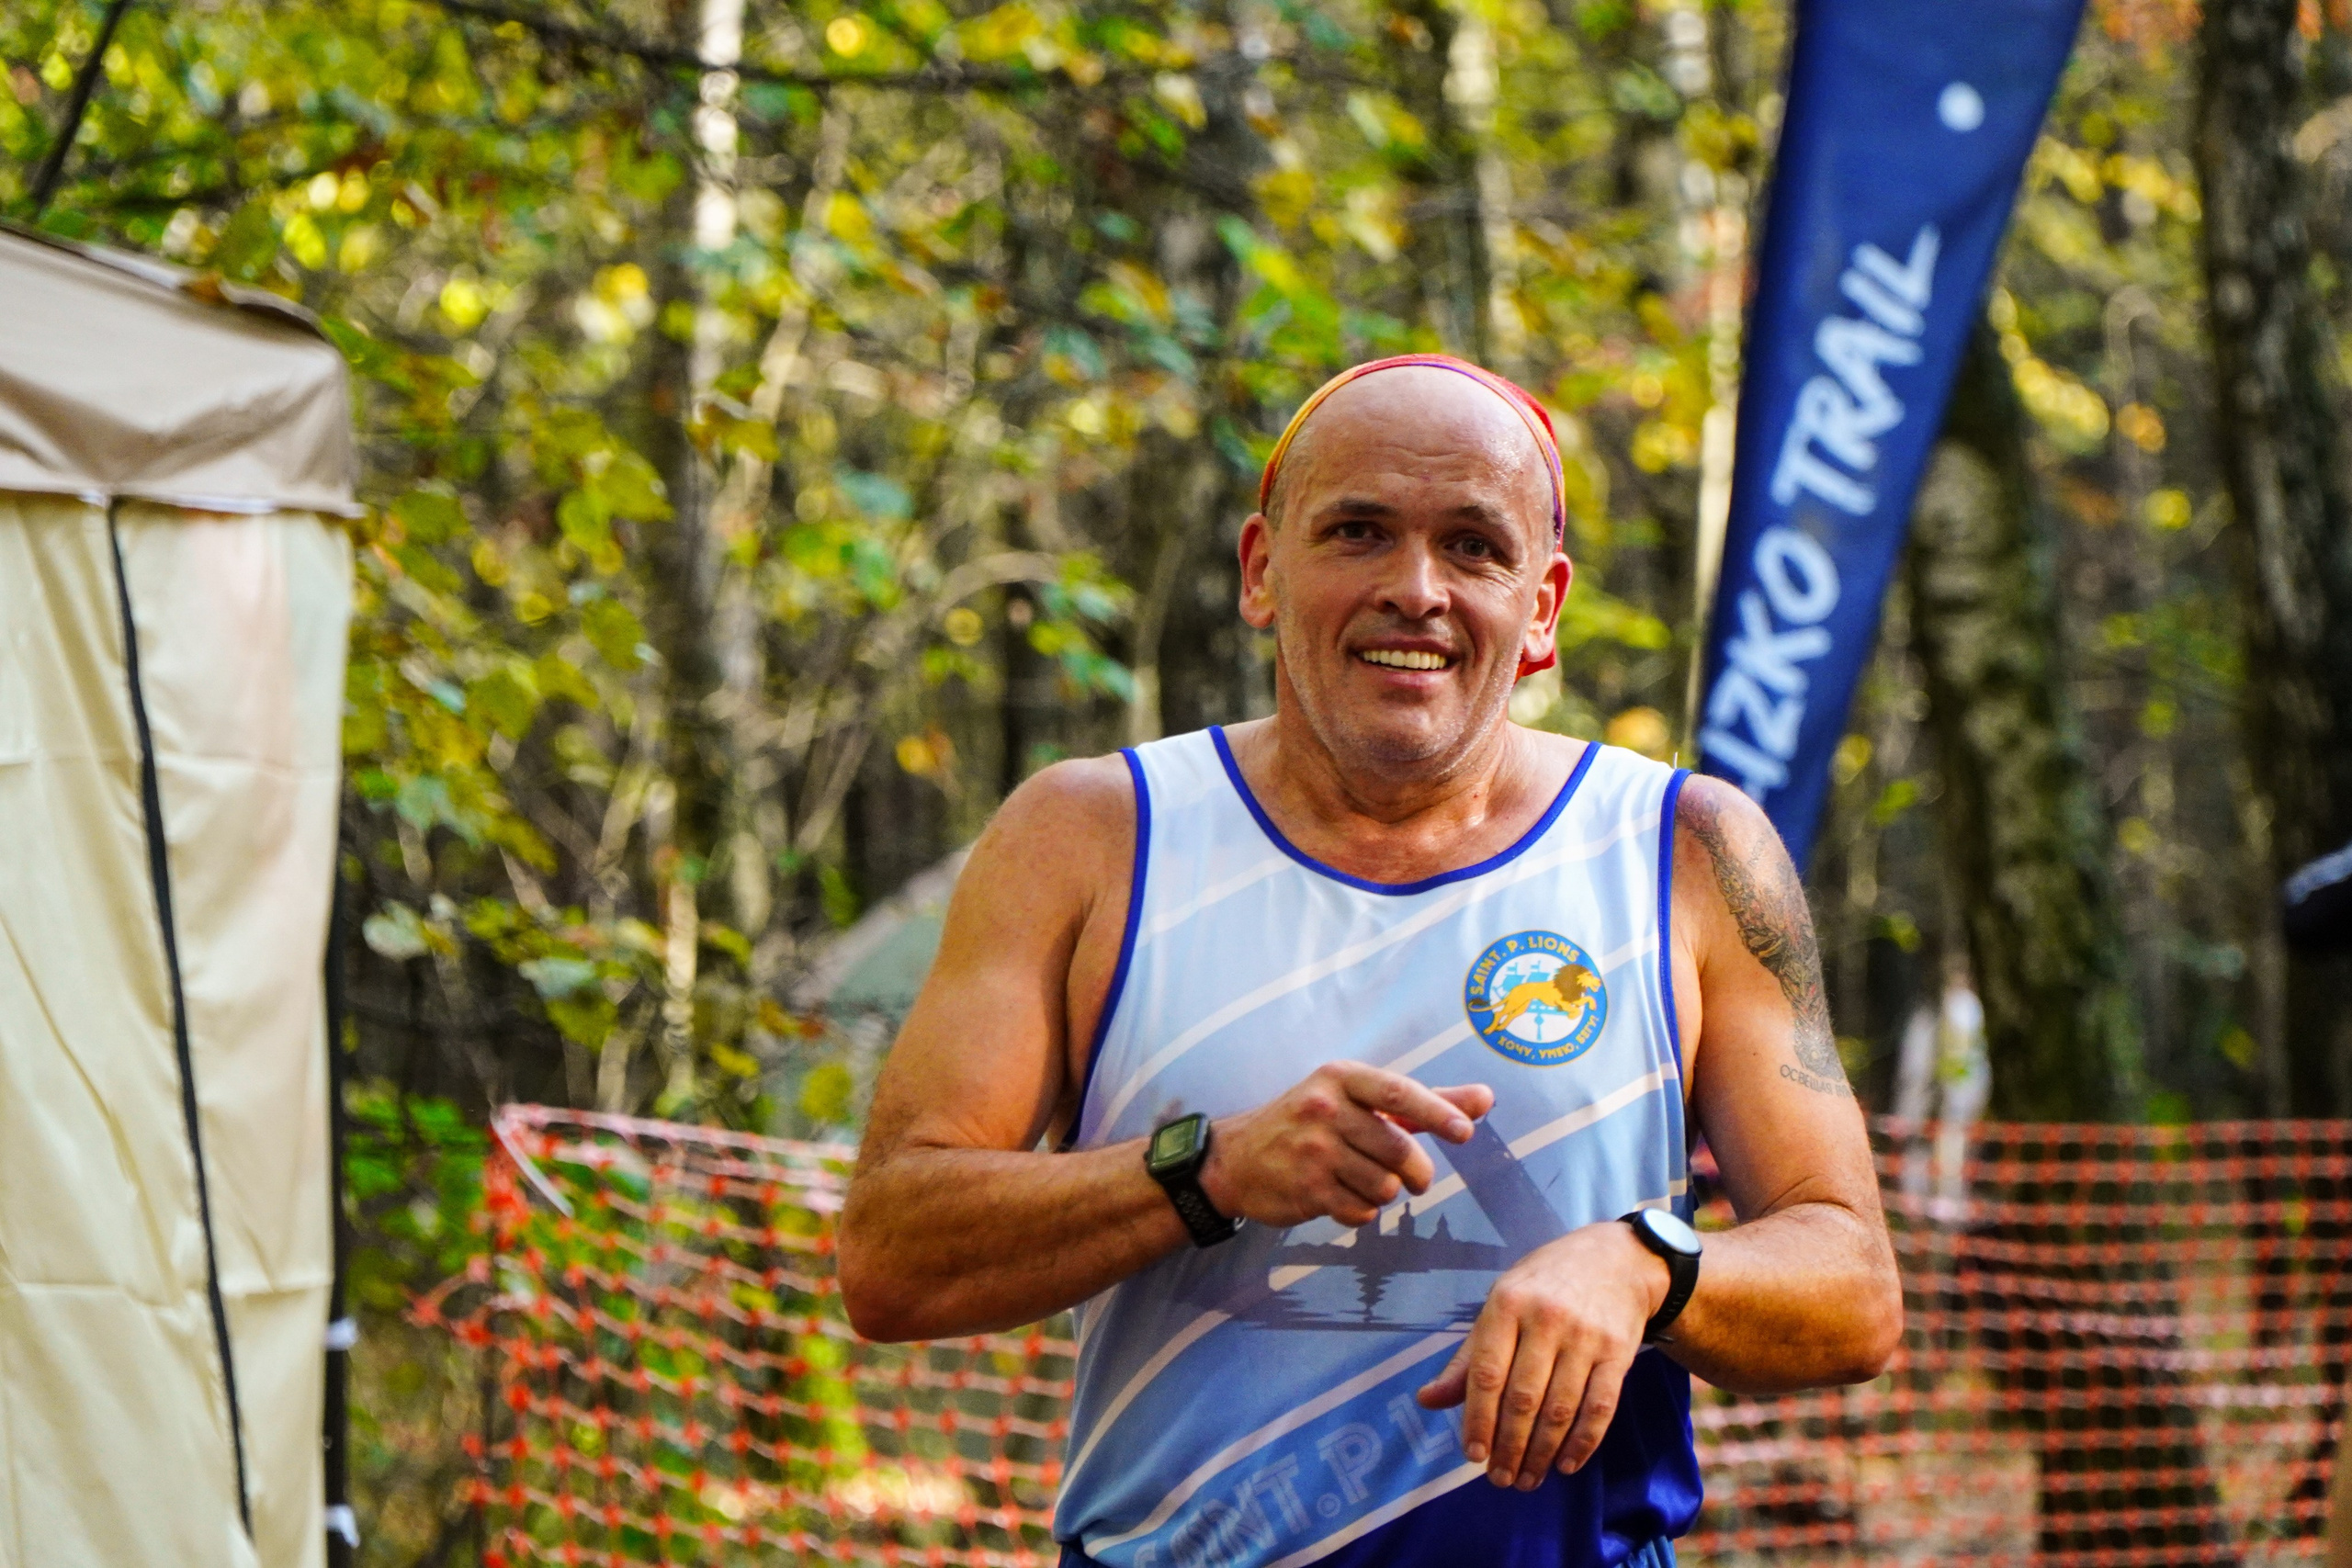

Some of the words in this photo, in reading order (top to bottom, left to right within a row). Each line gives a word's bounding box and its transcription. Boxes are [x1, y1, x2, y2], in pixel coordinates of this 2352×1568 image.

[1699, 525, 1840, 805] IZKO
[1770, 221, 1941, 517] TRAIL
[1527, 936, 1580, 963] LIONS
